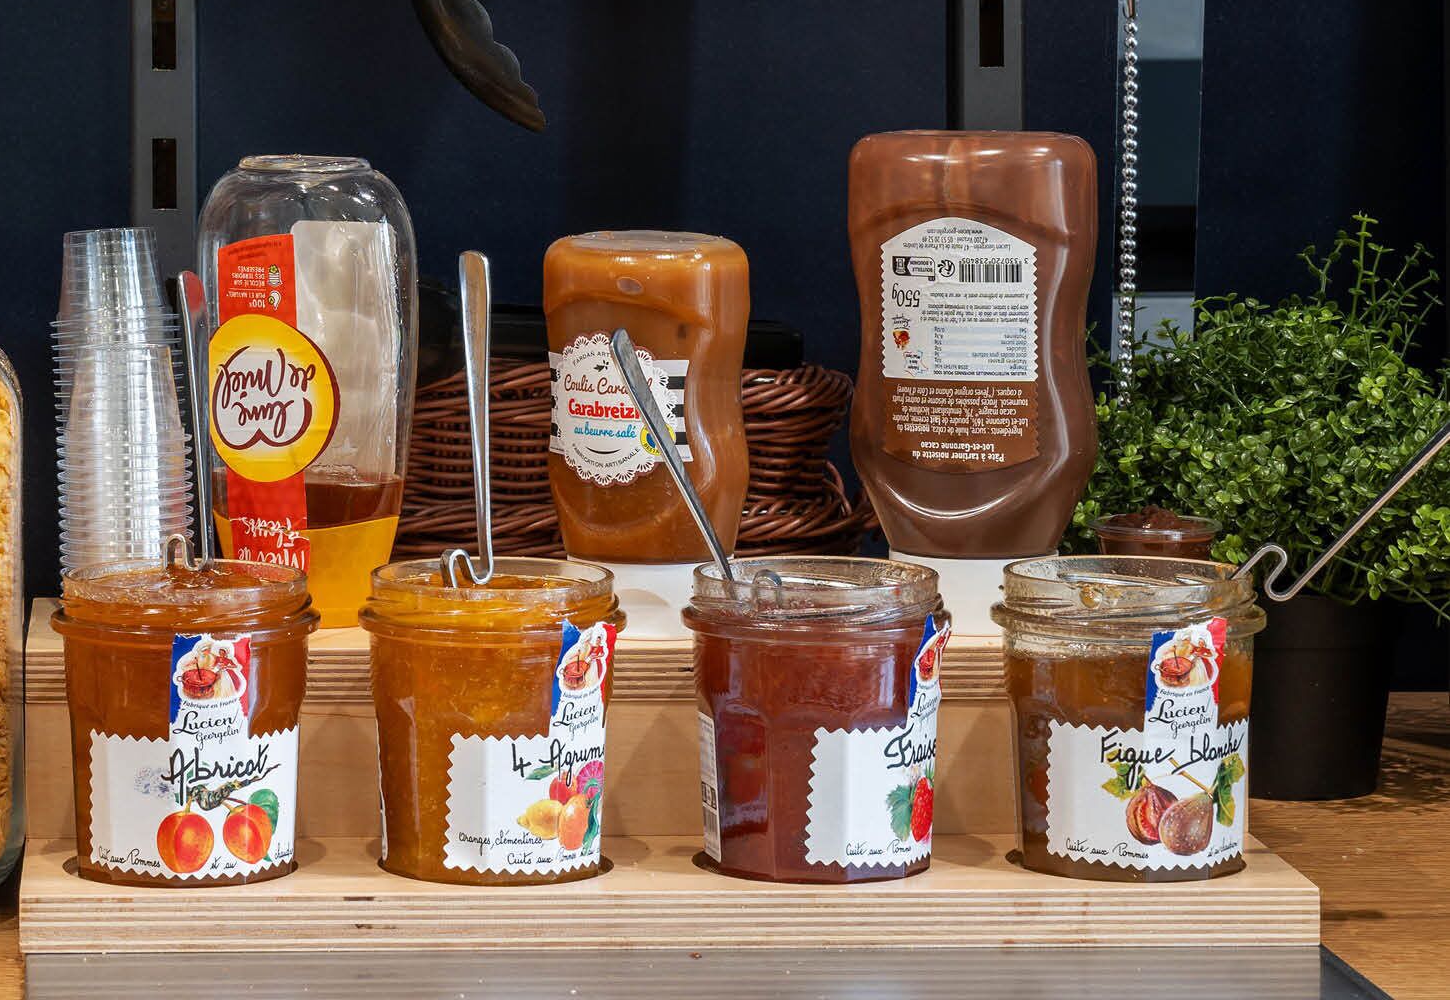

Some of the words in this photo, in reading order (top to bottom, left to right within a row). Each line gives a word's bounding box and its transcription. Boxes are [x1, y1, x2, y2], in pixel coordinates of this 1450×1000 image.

[892, 282, 921, 307] 550g
[218, 348, 286, 409] Miel
[288, 363, 316, 393] de
[564, 373, 595, 393] Coulis
[574, 425, 583, 434] au
[584, 421, 615, 438] beurre
[616, 424, 637, 438] salé
[912, 451, 921, 460] du
[920, 441, 939, 449] cacao
[922, 451, 949, 460] noisette
[941, 442, 995, 452] Lot-et-Garonne
[604, 447, 640, 468] ARTISANALE
[951, 452, 979, 462] tartiner
[981, 453, 986, 462] à
[987, 453, 1005, 463] Pâte
[172, 710, 236, 735] Lucien
[552, 701, 597, 727] Lucien
[1148, 699, 1207, 724] Lucien
[195, 724, 240, 751] Georgelin
[1170, 713, 1211, 740] Georgelin
[511, 742, 531, 779] 4
[1100, 730, 1176, 789] Figue
[1172, 732, 1245, 775] blanche
[161, 744, 270, 806] Abricot
[110, 856, 127, 864] aux
[127, 848, 161, 868] Pommes
[1065, 837, 1089, 852] Cuite
[1090, 847, 1109, 855] aux
[1113, 841, 1149, 859] Pommes
